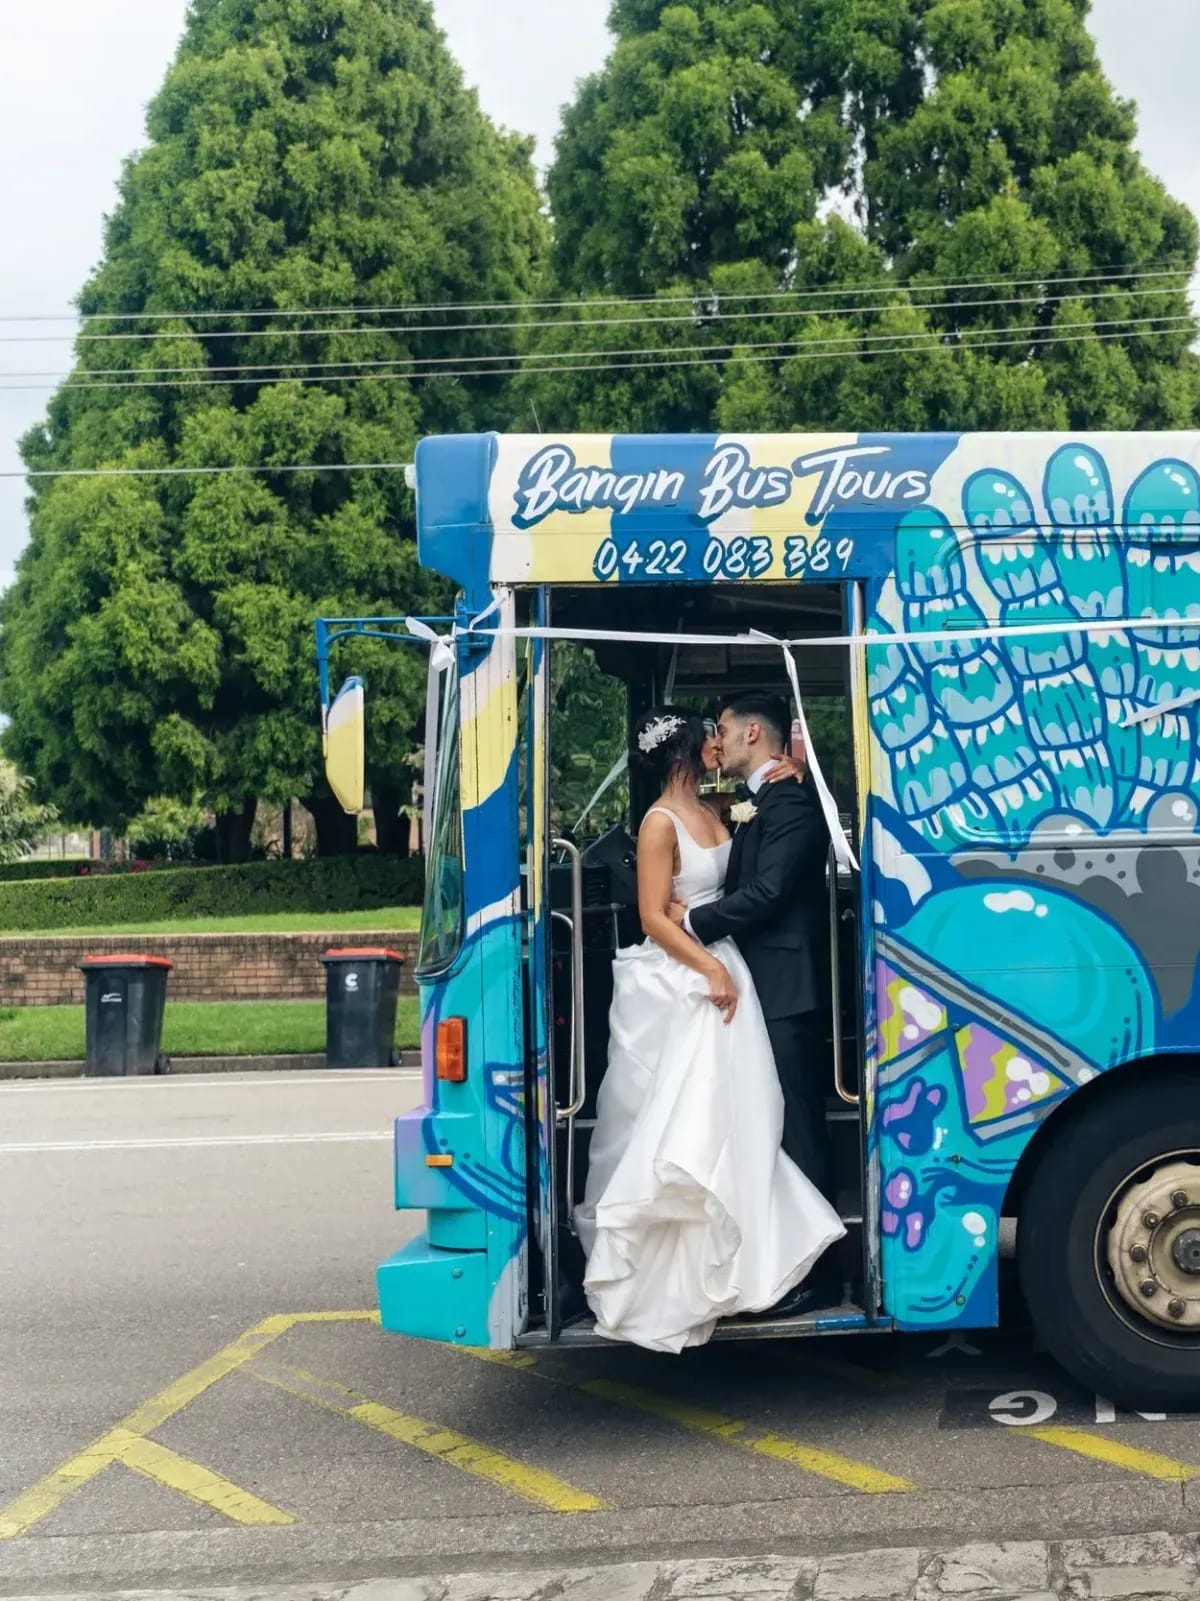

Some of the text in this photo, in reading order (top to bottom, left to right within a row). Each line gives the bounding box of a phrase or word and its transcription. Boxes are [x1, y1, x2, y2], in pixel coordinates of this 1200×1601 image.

[519, 445, 929, 520] Bangin Bus Tours
[596, 537, 854, 575] 0422 083 389
